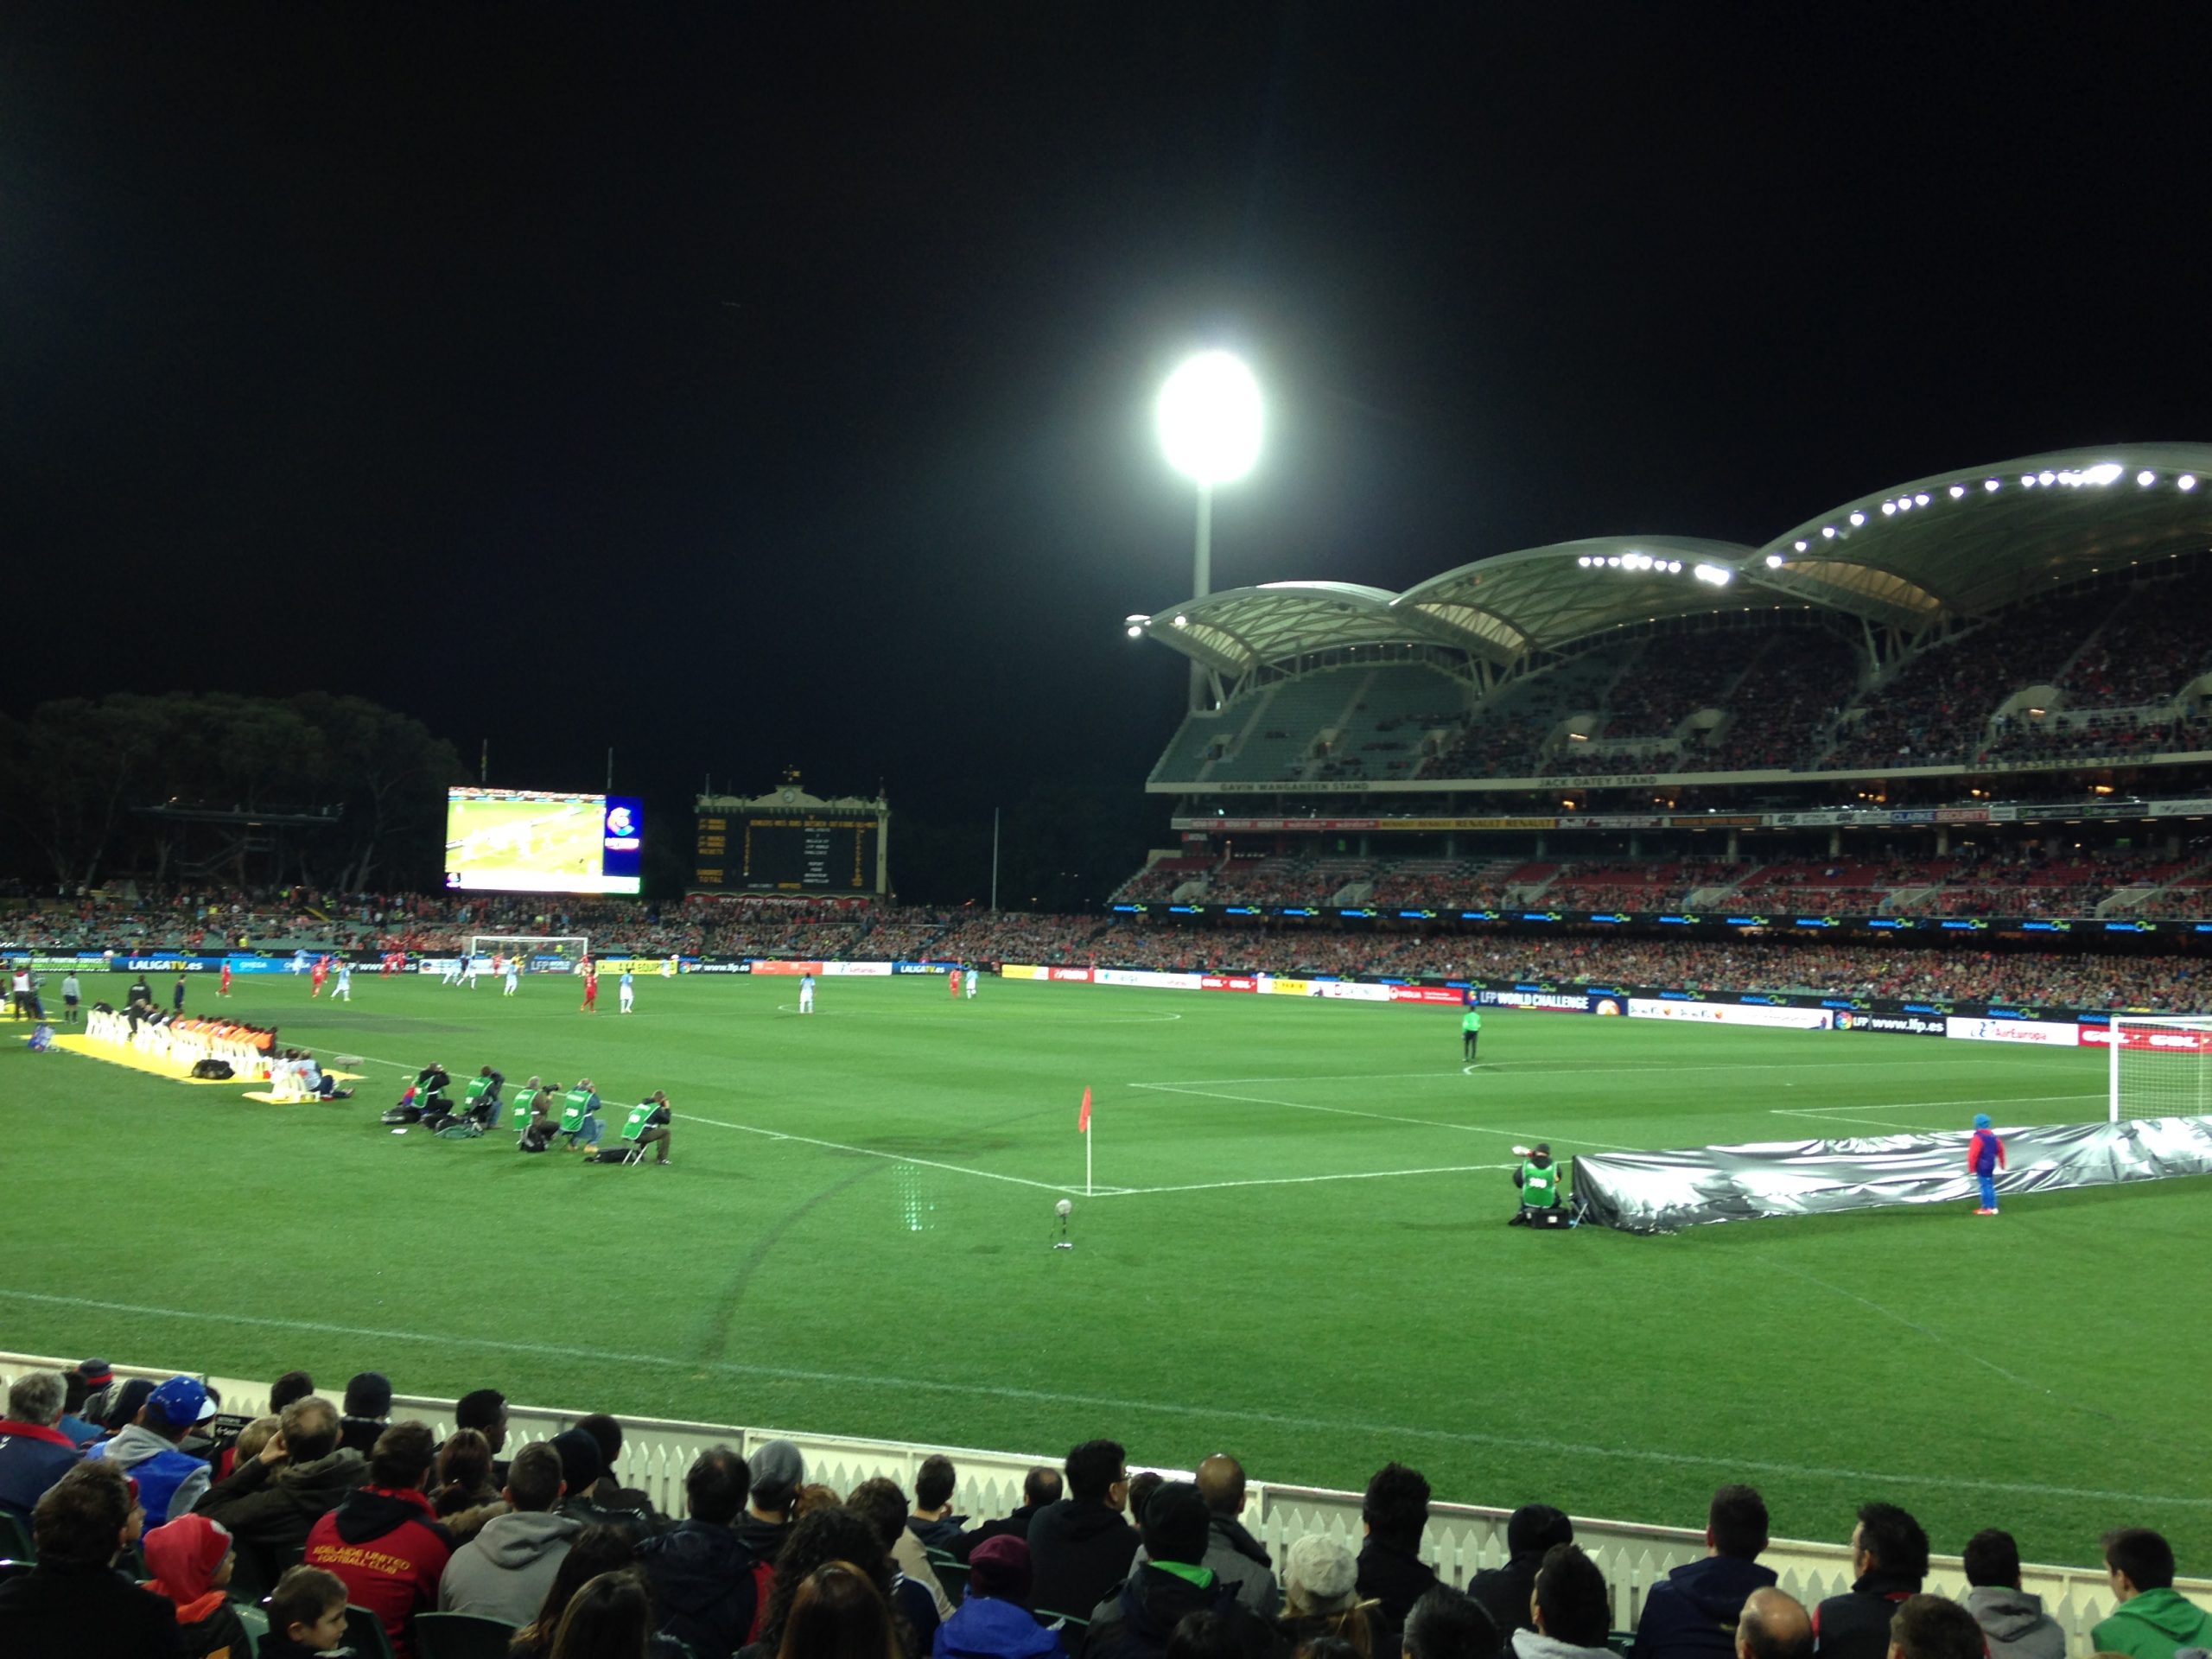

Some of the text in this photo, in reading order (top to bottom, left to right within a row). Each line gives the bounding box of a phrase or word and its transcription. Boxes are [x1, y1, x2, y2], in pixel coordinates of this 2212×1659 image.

[1258, 783, 1328, 791] WANGANEEN
[1538, 776, 1657, 787] JACK OATEY STAND
[128, 960, 204, 970] LALIGATV.es
[1480, 992, 1589, 1009] LFP WORLD CHALLENGE
[1853, 1017, 1944, 1033] LFP www.lfp.es
[313, 1545, 411, 1570] ADELAIDE UNITED
[317, 1554, 399, 1574] FOOTBALL CLUB
